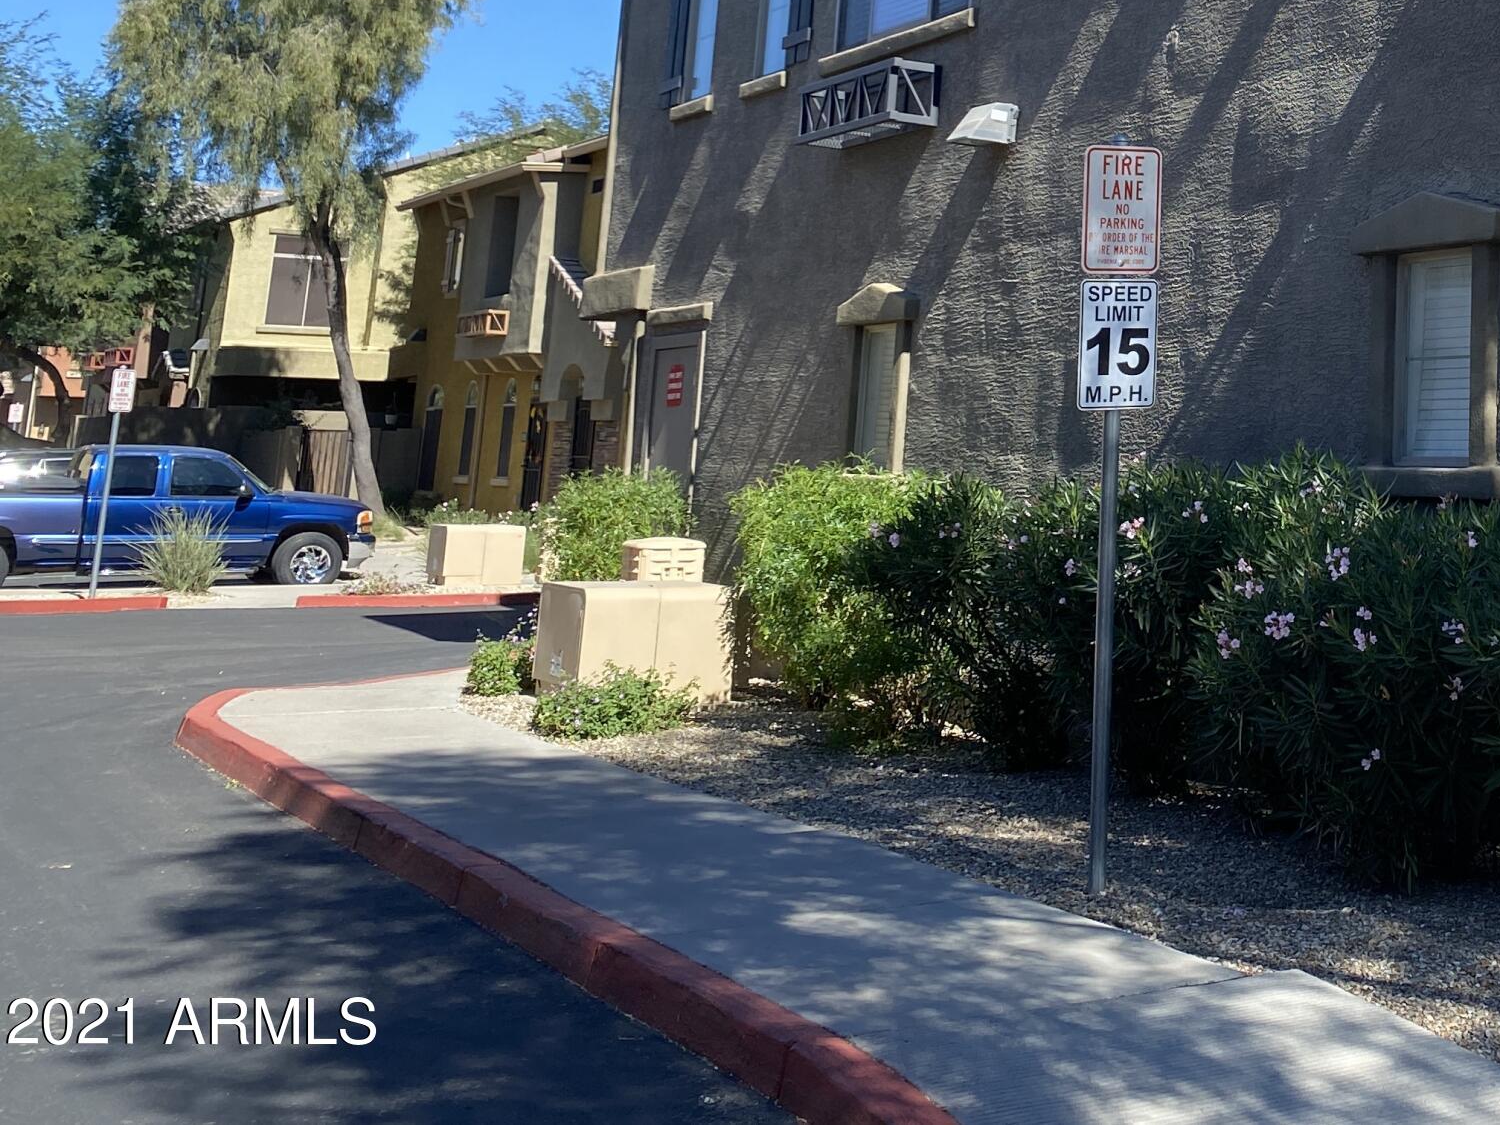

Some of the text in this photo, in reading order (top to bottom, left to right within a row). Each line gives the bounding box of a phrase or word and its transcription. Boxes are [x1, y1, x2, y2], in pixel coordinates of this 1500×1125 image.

[1103, 154, 1145, 176] FIRE
[1102, 179, 1144, 201] LANE
[1115, 203, 1130, 216] NO
[1099, 217, 1145, 230] PARKING
[1102, 232, 1126, 243] ORDER
[1128, 233, 1138, 243] OF
[1141, 233, 1155, 244] THE
[1113, 245, 1149, 256] MARSHAL
[1088, 285, 1153, 302] SPEED
[1095, 305, 1145, 322] LIMIT
[1086, 327, 1150, 376] 15
[1085, 385, 1148, 403] M.P.H.
